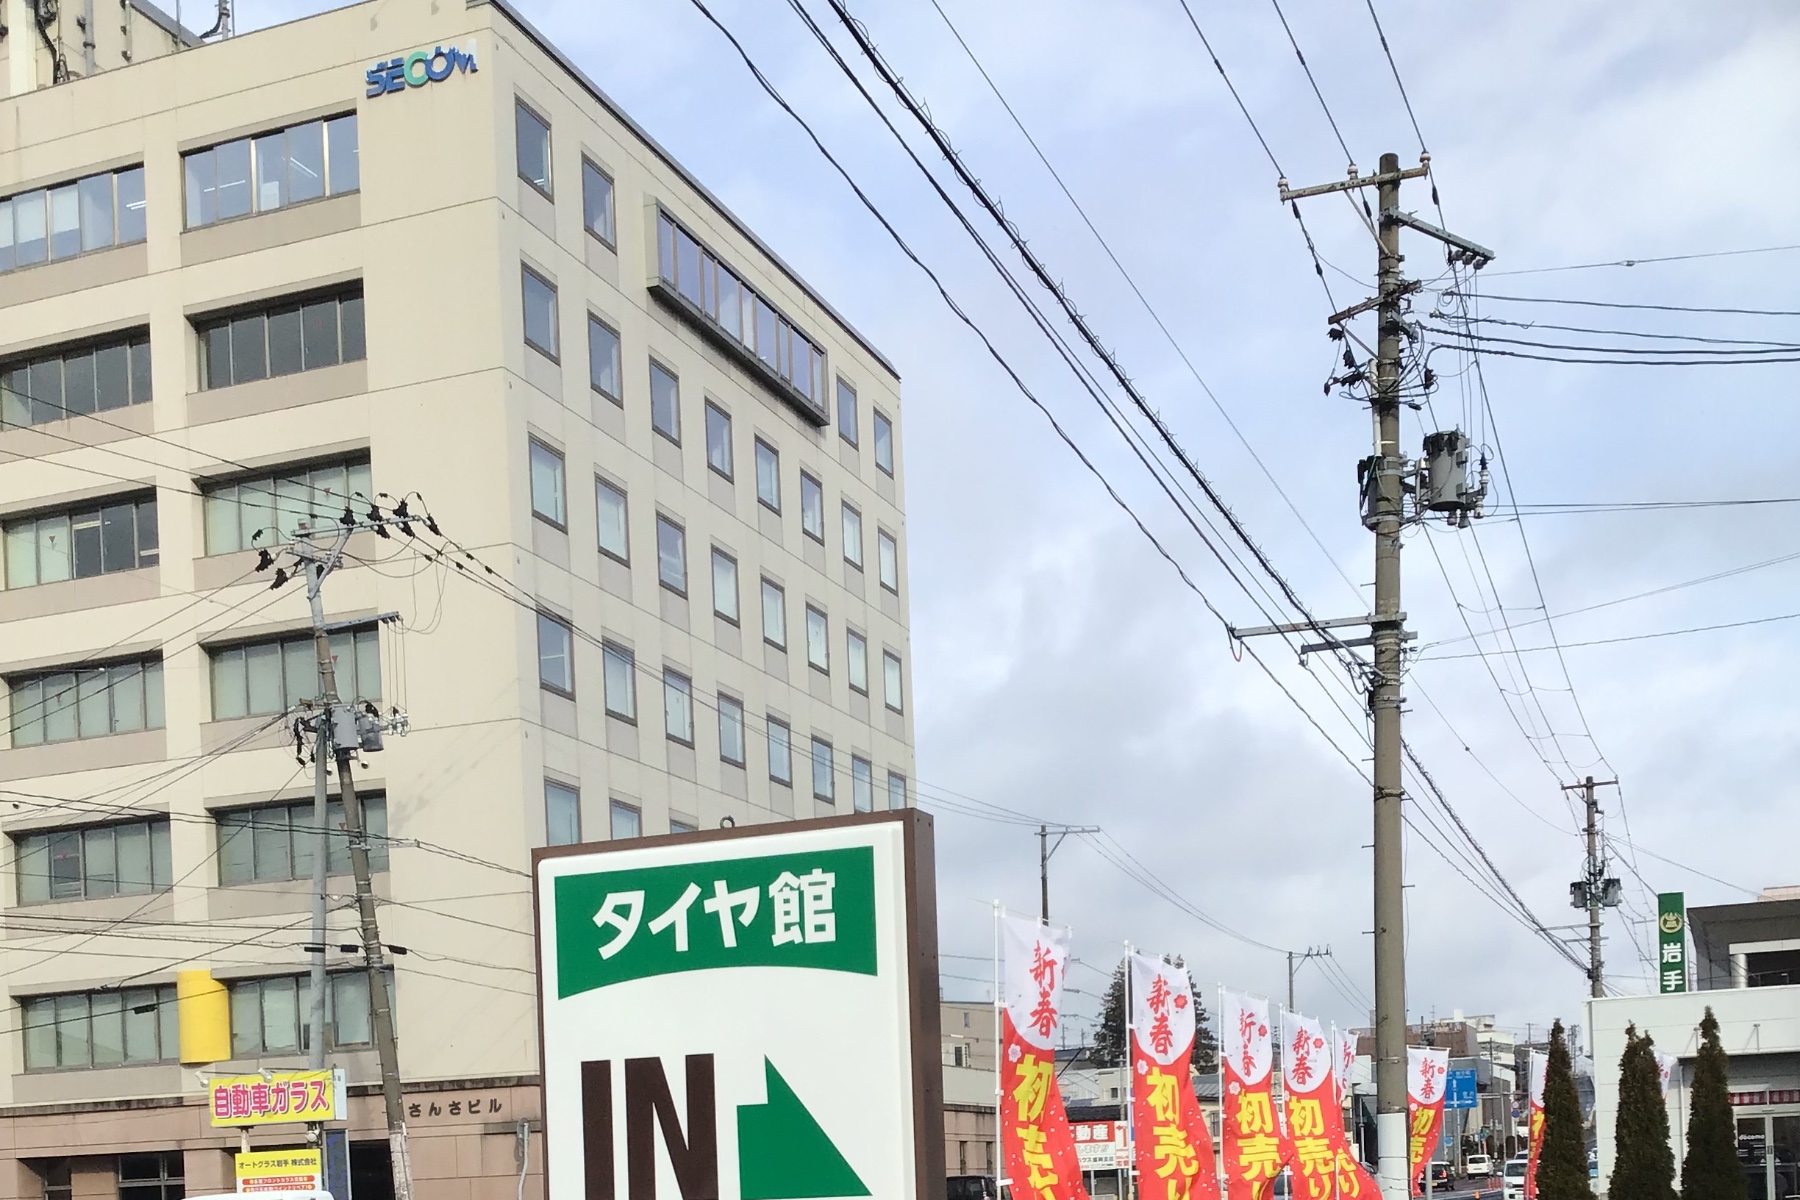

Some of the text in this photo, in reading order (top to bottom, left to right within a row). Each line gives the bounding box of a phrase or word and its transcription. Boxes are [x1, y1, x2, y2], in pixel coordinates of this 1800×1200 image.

[366, 41, 478, 98] SECOM
[592, 868, 836, 960] タイヤ館
[1029, 940, 1058, 1039] 新春
[1662, 942, 1684, 991] 岩手
[1147, 974, 1174, 1055] 新春
[1239, 1008, 1257, 1077] 新春
[1291, 1026, 1313, 1086] 新春
[1419, 1057, 1437, 1099] 新春
[214, 1080, 328, 1118] 自動車ガラス
[408, 1098, 502, 1118] さんさビル
[1410, 1106, 1436, 1180] 初売
